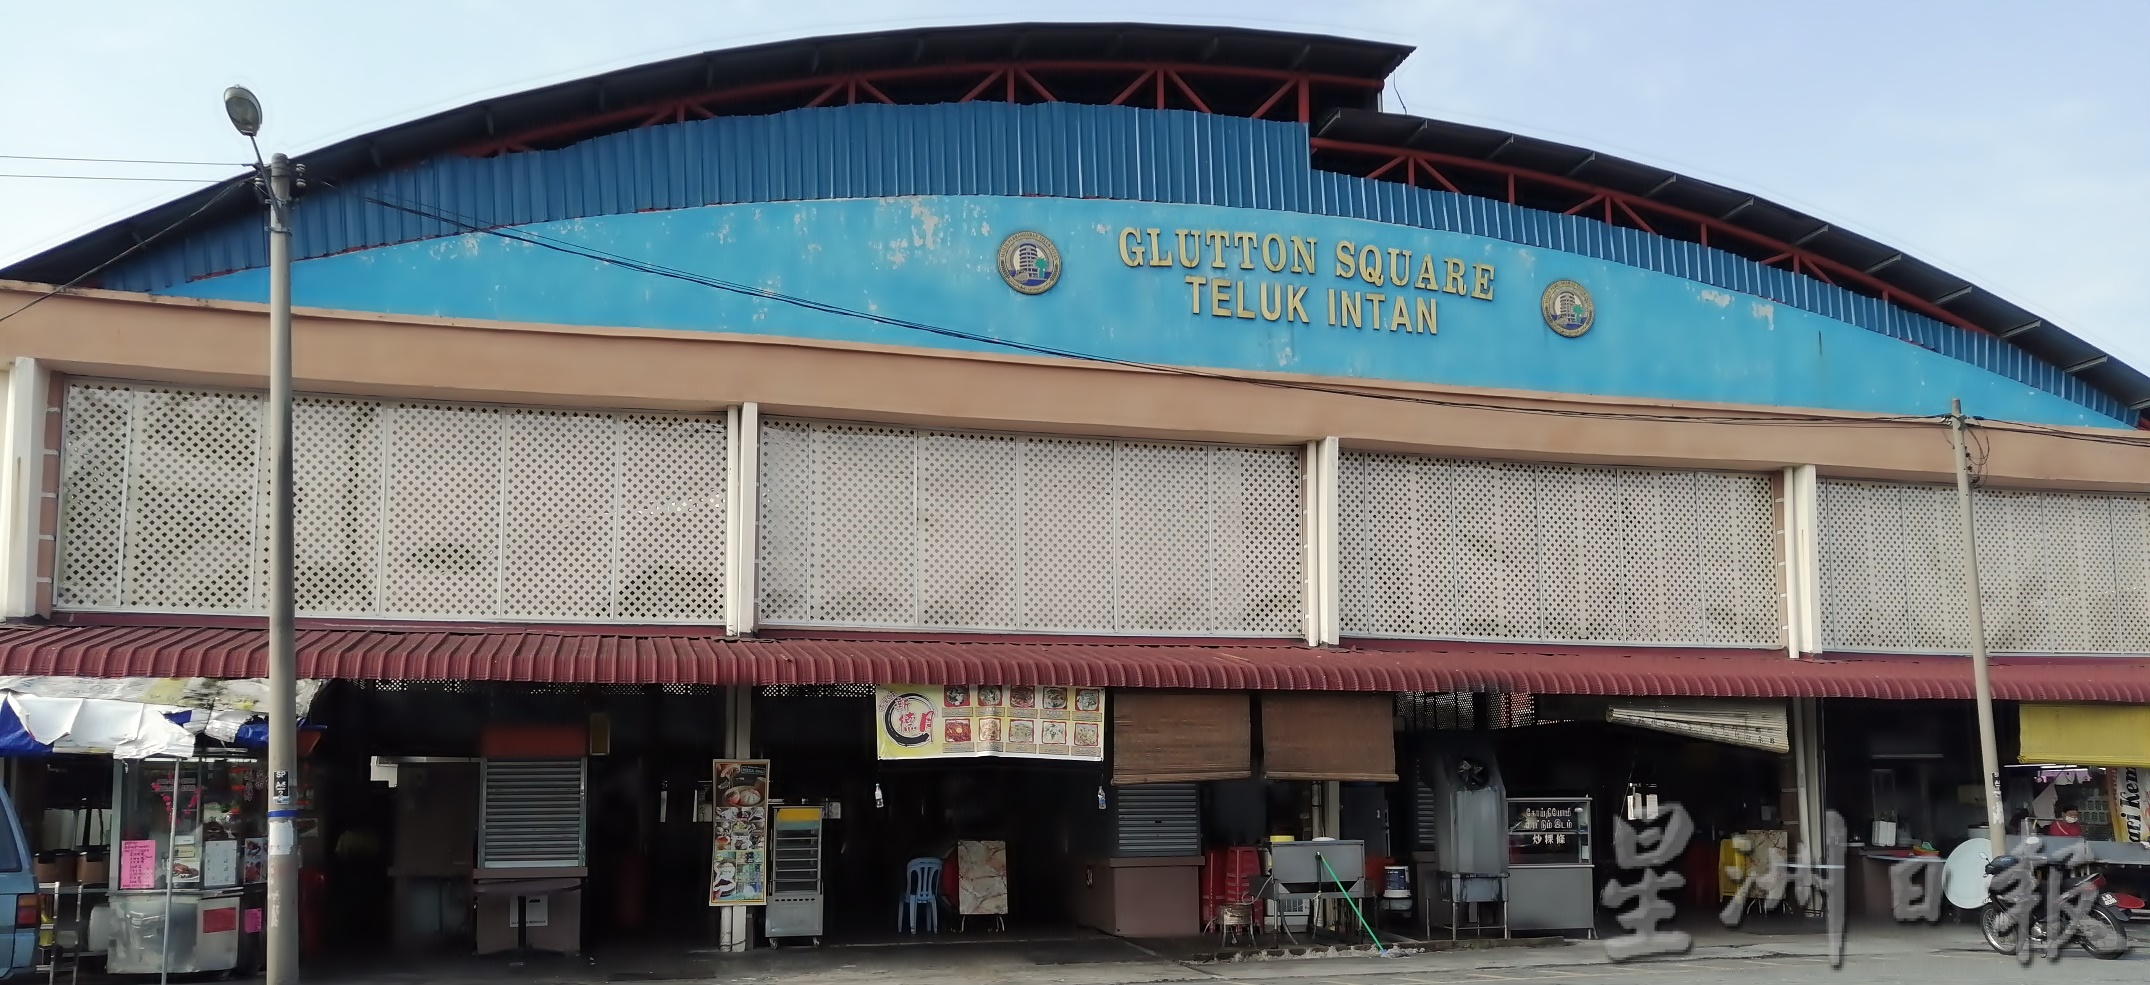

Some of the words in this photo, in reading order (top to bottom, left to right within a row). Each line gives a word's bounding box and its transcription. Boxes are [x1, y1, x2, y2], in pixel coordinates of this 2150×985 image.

[1118, 227, 1317, 275] GLUTTON
[1335, 240, 1495, 301] SQUARE
[1185, 275, 1310, 323] TELUK
[1328, 288, 1437, 335] INTAN
[1532, 834, 1566, 845] 炒粿條
